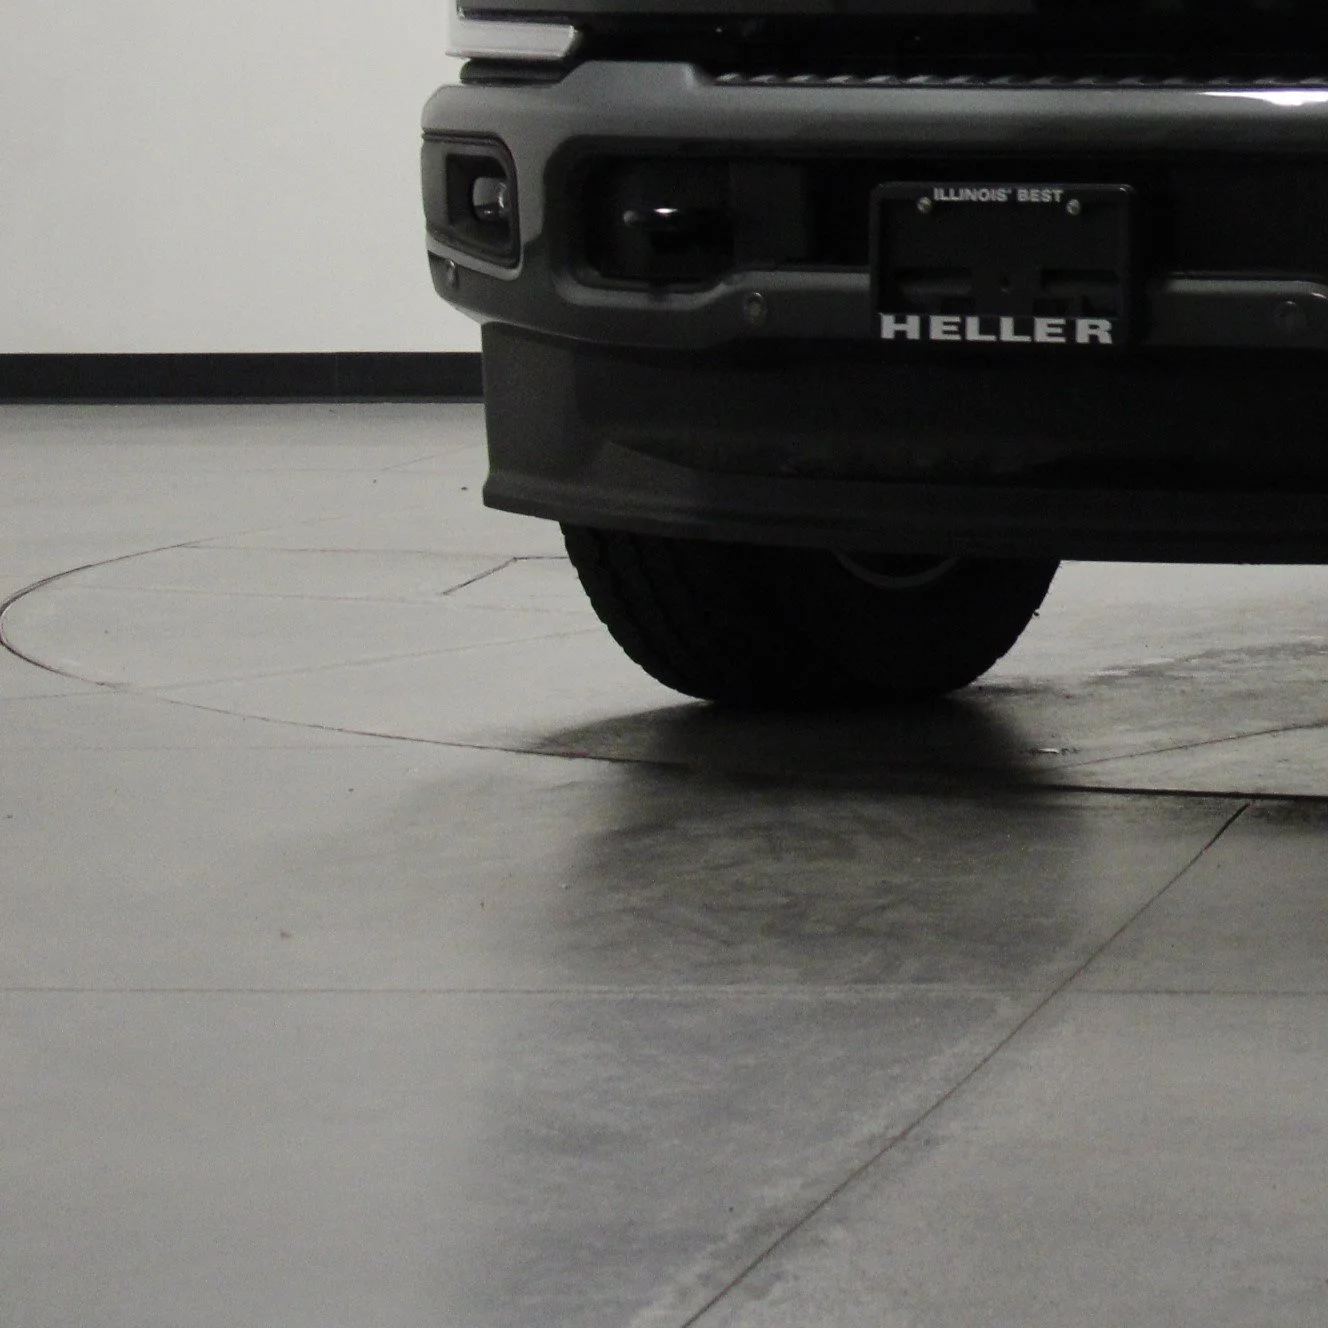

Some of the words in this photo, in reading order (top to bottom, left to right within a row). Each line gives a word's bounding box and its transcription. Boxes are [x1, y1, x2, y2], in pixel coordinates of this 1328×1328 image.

[933, 187, 1012, 202] ILLINOIS'
[1017, 188, 1064, 203] BEST
[879, 314, 1113, 344] HELLER
